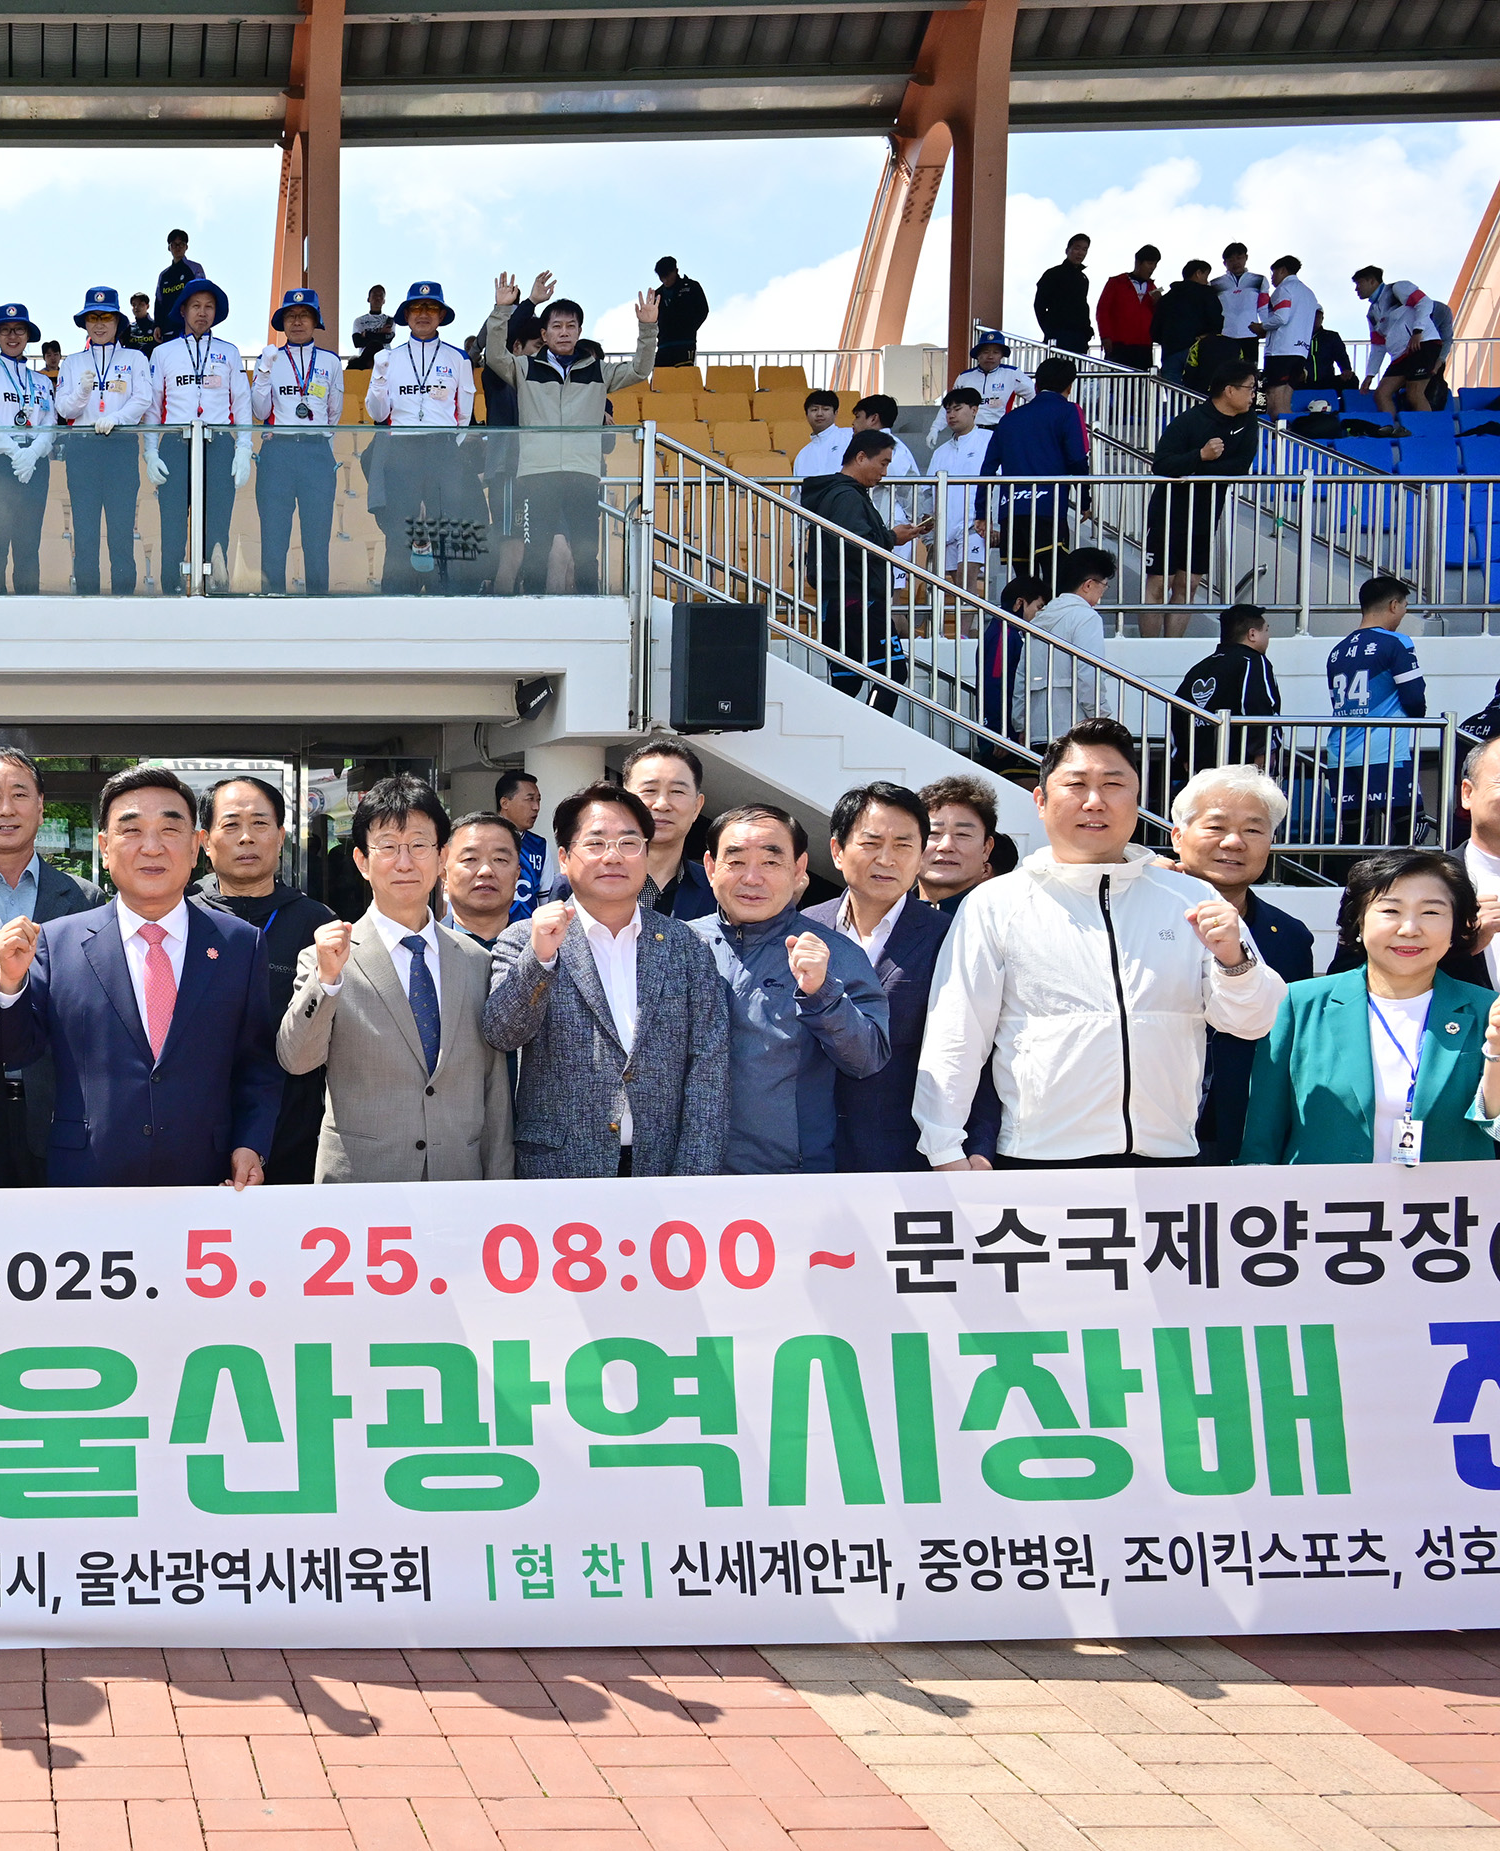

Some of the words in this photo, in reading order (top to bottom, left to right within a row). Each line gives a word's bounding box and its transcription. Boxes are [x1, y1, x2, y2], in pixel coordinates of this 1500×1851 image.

[1332, 669, 1371, 710] 34
[529, 853, 542, 871] 43
[184, 1229, 267, 1299] 5.
[300, 1225, 448, 1296] 25.
[481, 1220, 776, 1294] 08:00
[76, 1545, 432, 1607] 울산광역시체육회
[669, 1538, 905, 1601] 신세계안과,
[917, 1533, 1109, 1597] 중앙병원,
[1124, 1528, 1402, 1589] 조이킥스포츠,
